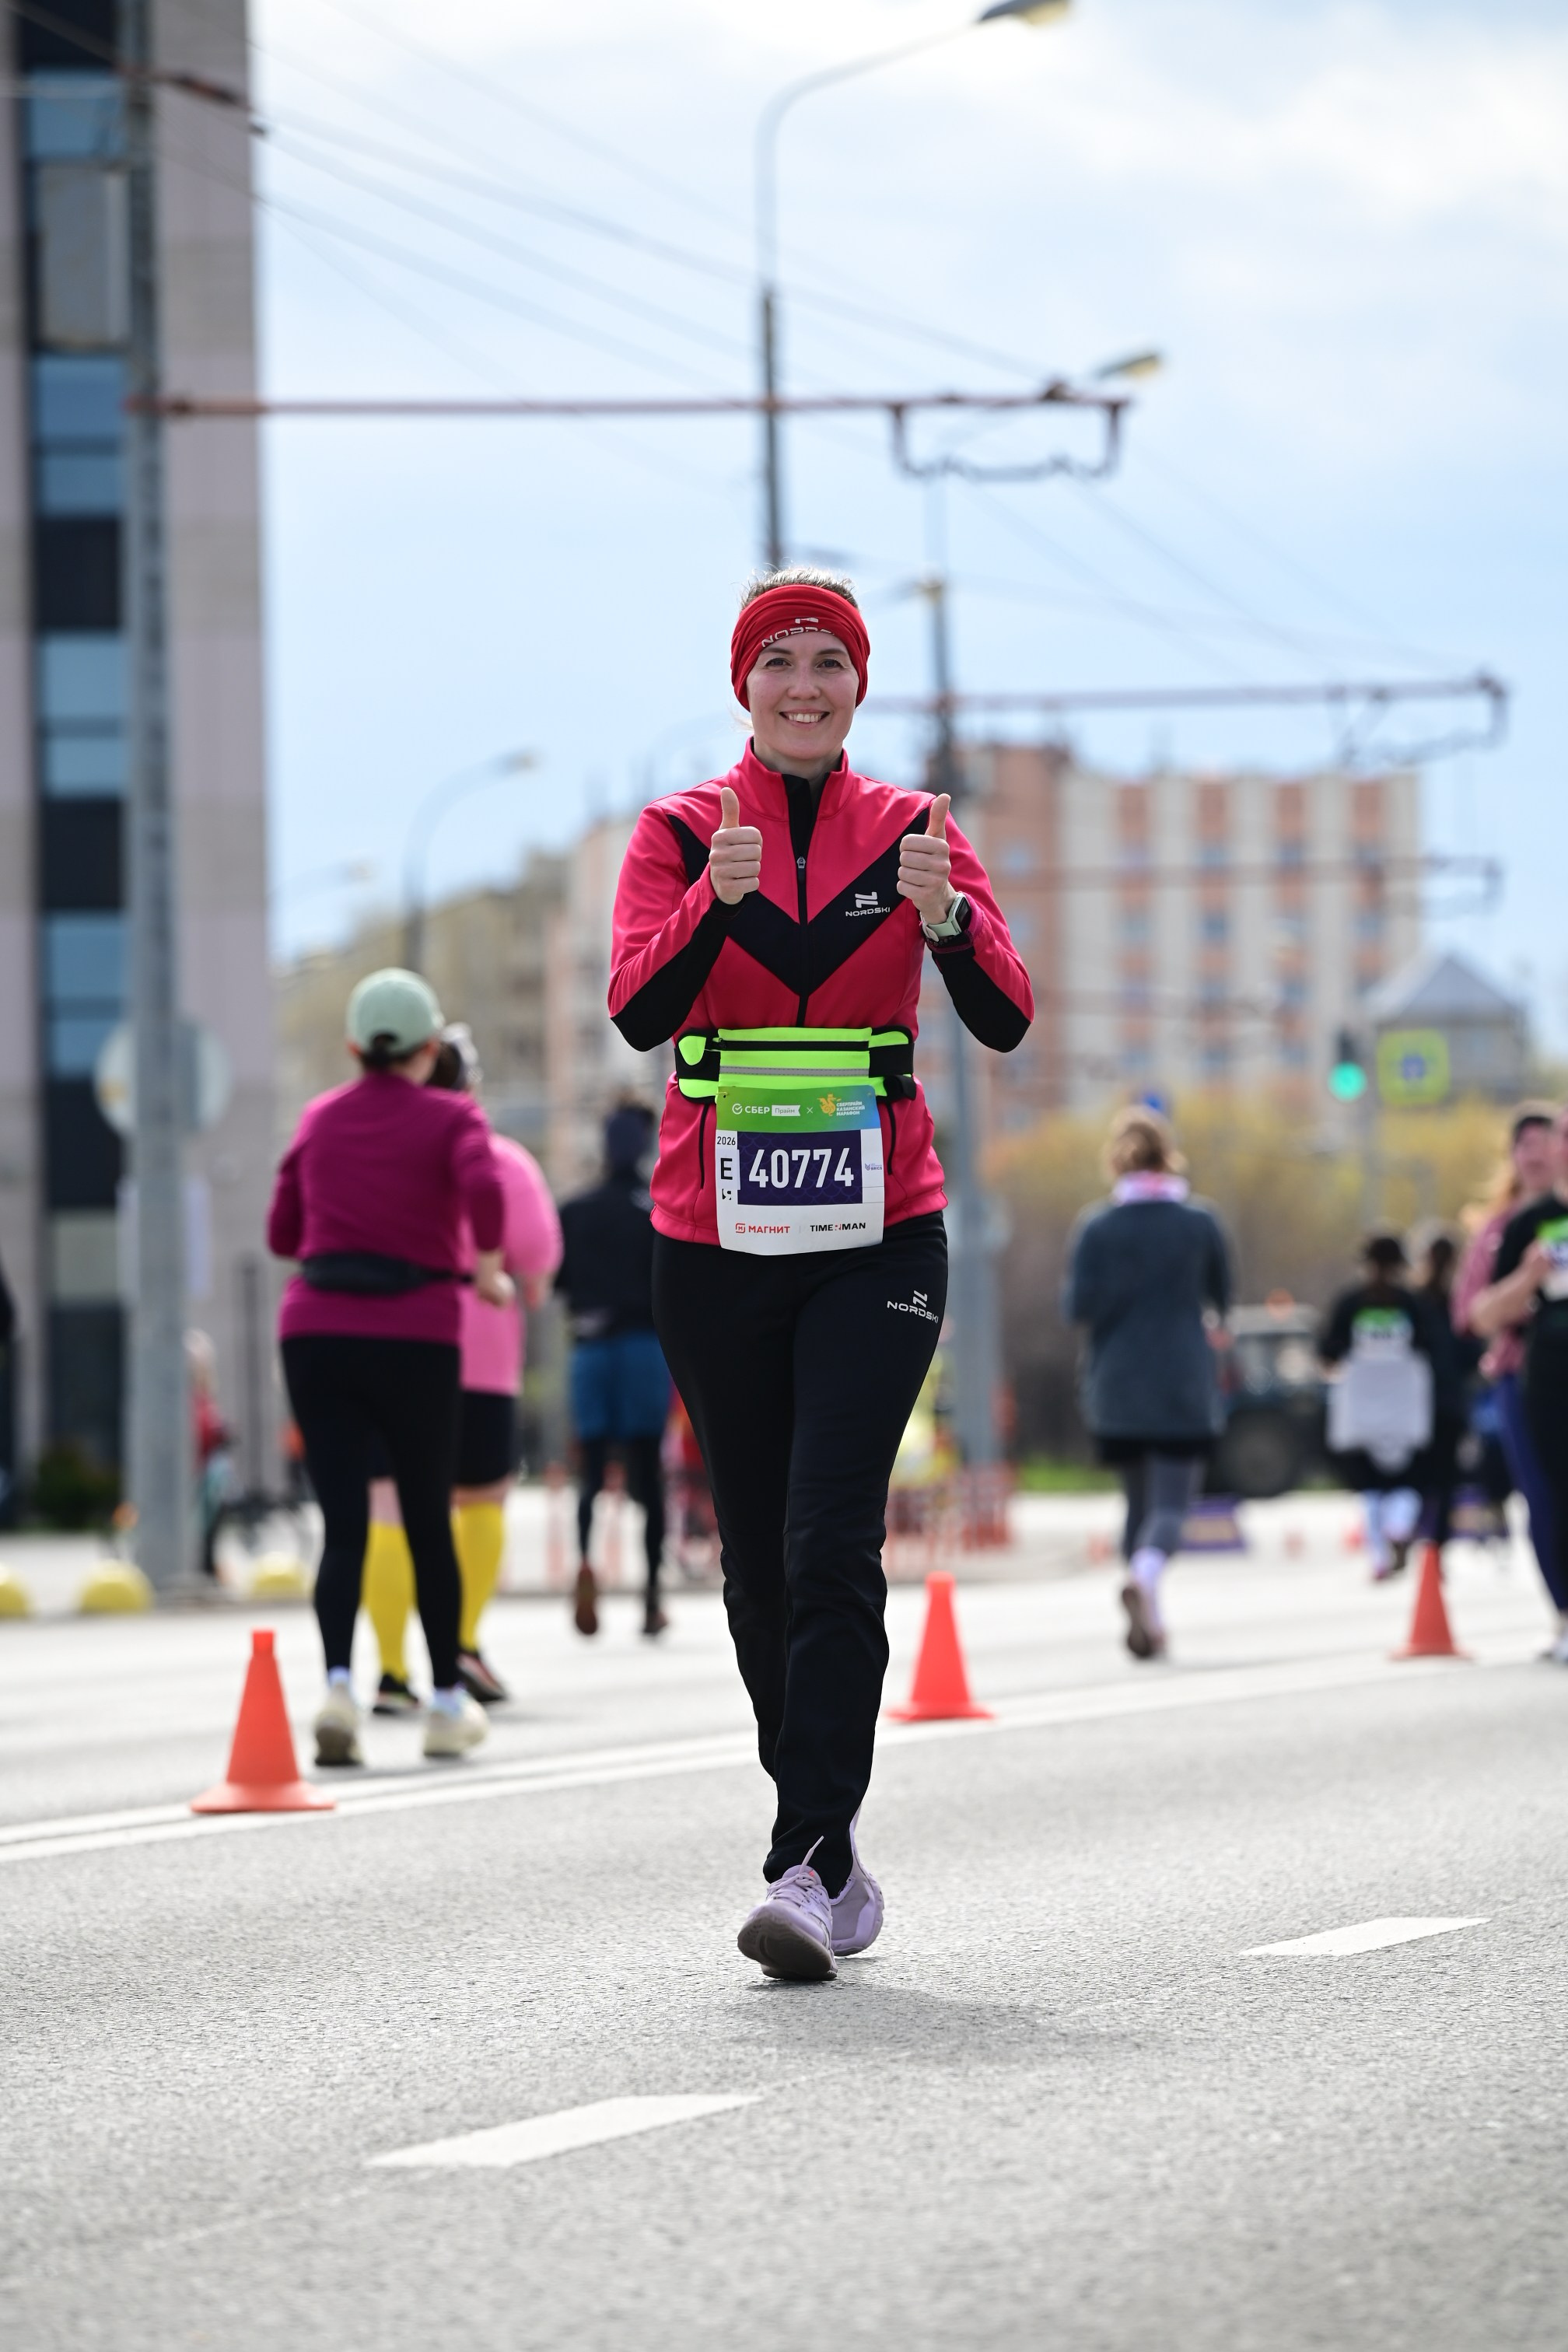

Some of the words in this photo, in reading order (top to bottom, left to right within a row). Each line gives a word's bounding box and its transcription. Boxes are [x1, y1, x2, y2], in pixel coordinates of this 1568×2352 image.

[845, 907, 891, 917] NORDSKI
[744, 1105, 770, 1115] СБЕР
[717, 1136, 736, 1146] 2026
[720, 1158, 733, 1180] E
[748, 1147, 855, 1188] 40774
[748, 1225, 790, 1234] МАГНИТ
[887, 1300, 939, 1324] NORDSKI
